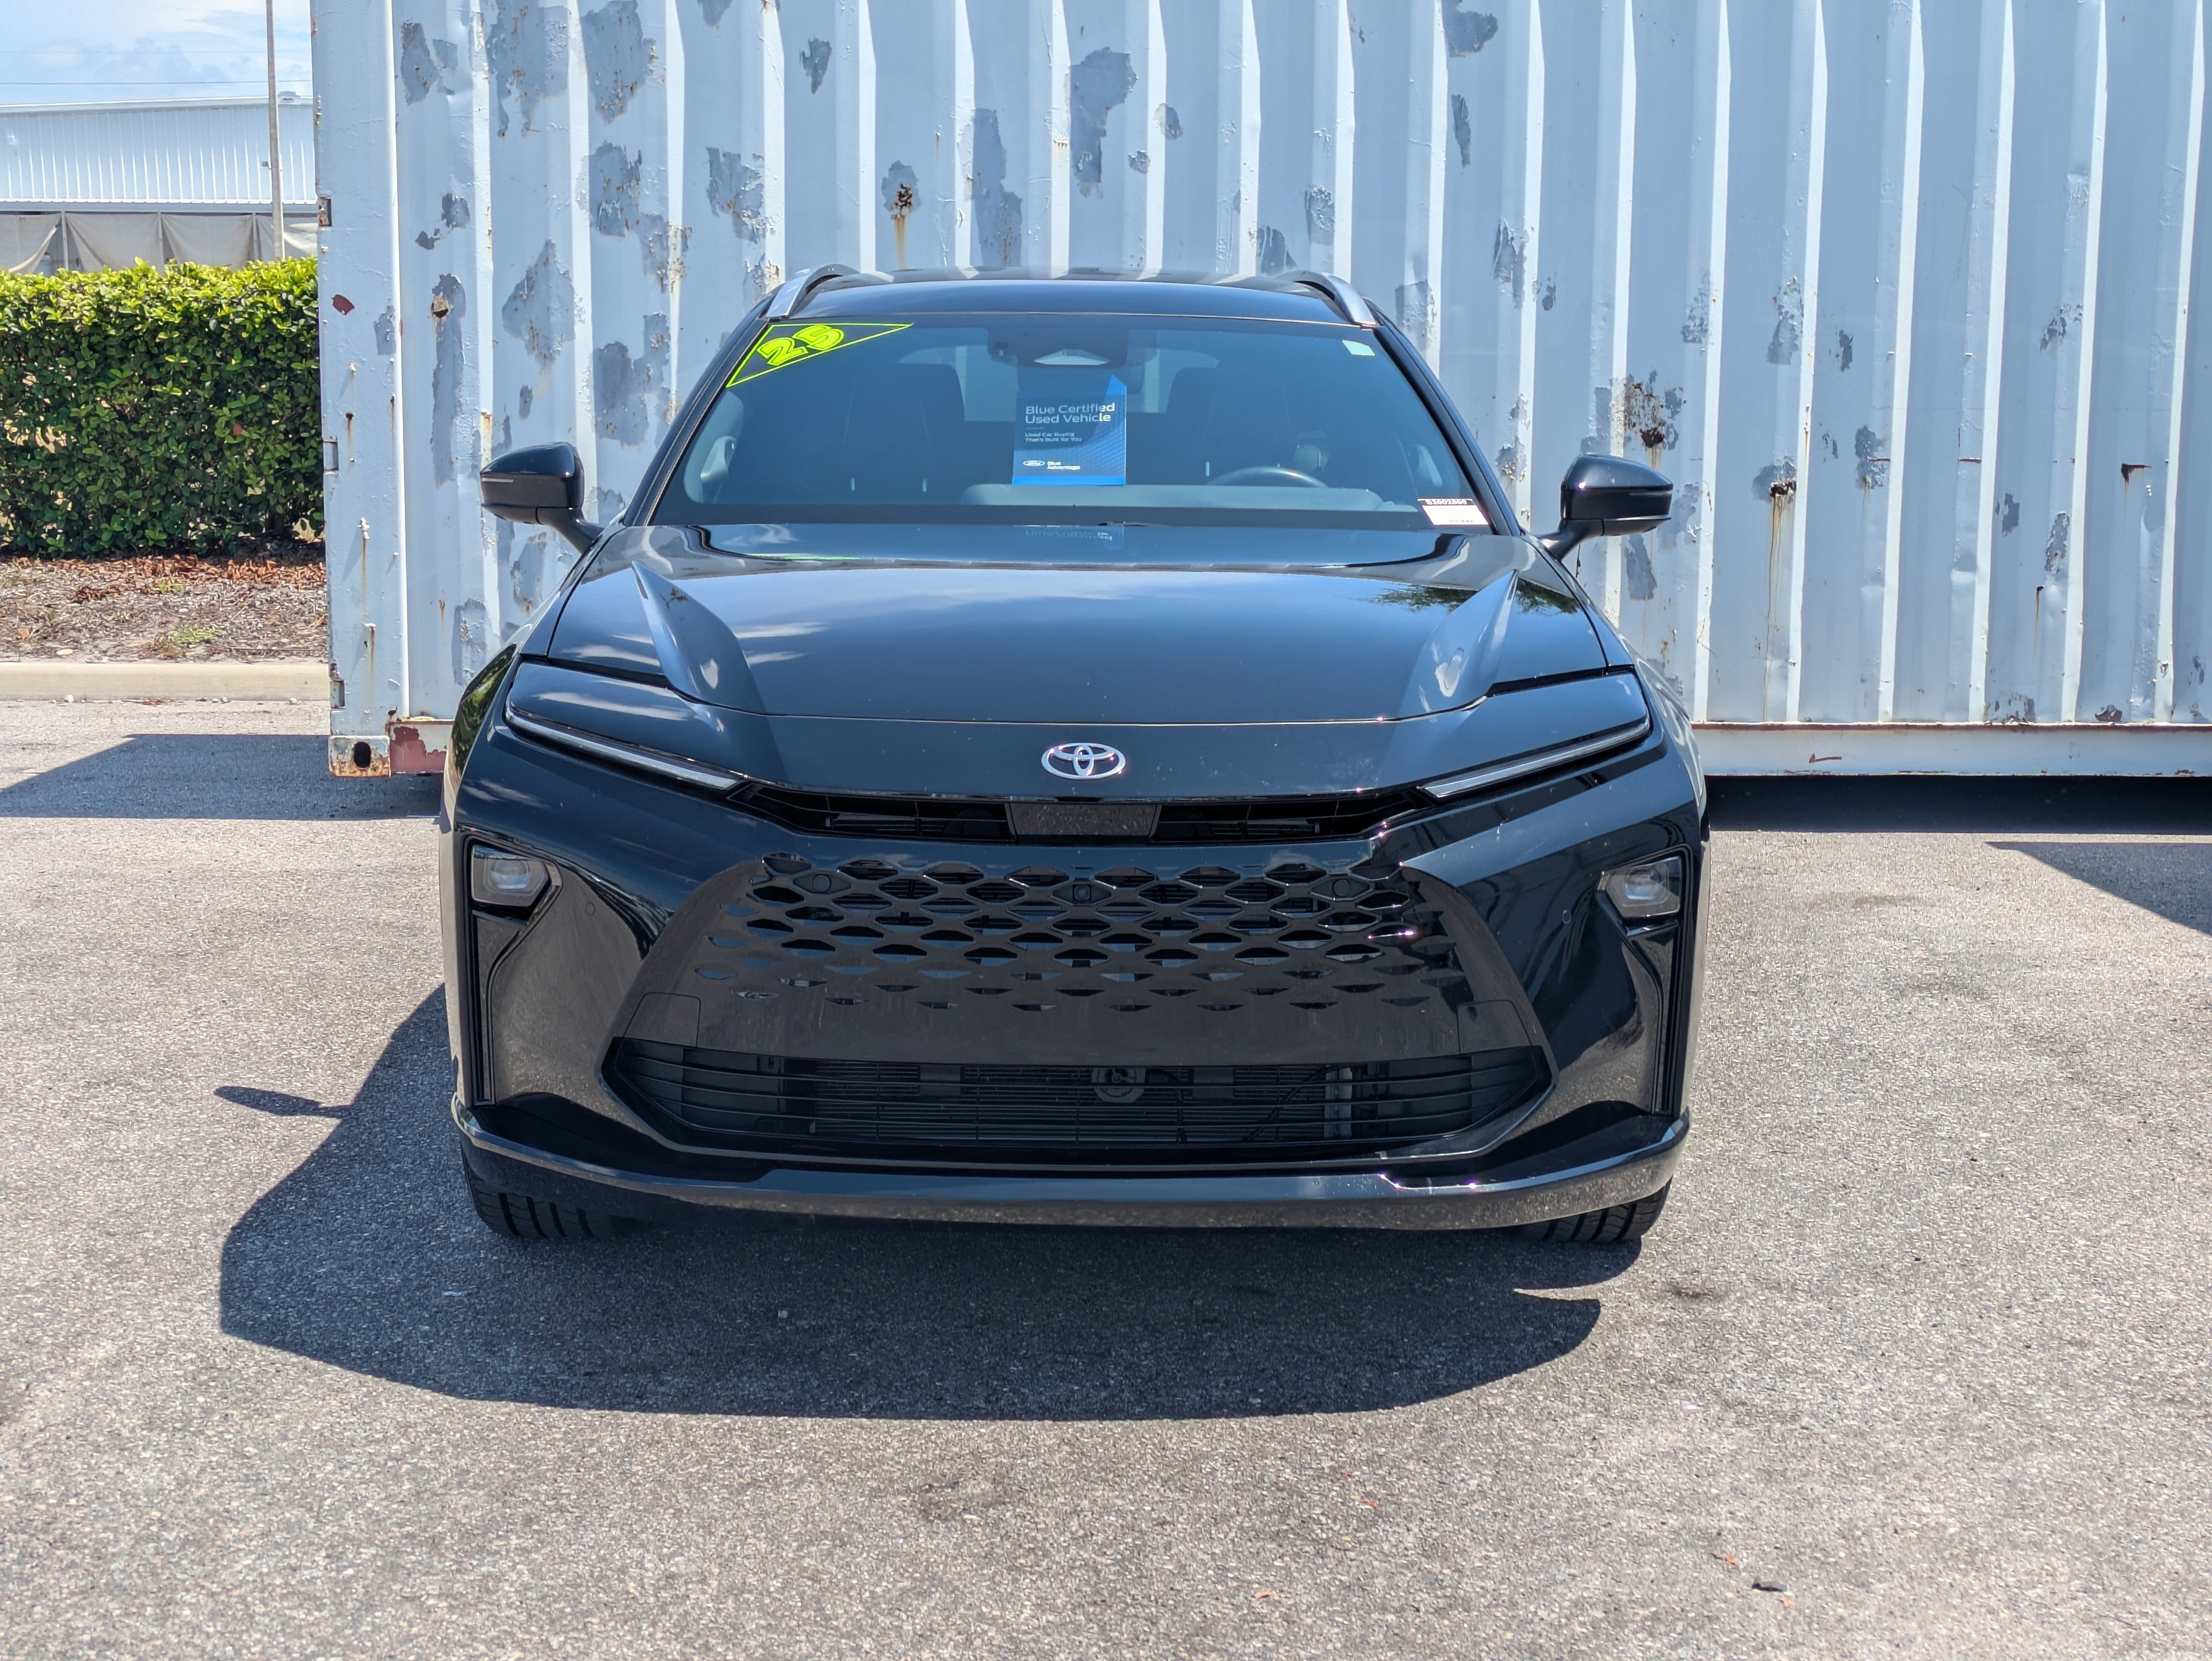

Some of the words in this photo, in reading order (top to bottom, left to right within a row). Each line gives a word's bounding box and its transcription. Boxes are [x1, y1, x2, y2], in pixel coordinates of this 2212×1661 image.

[757, 324, 845, 366] 25
[1026, 406, 1055, 414] Blue
[1058, 402, 1115, 413] Certified
[1026, 414, 1060, 424] Used
[1063, 412, 1111, 423] Vehicle
